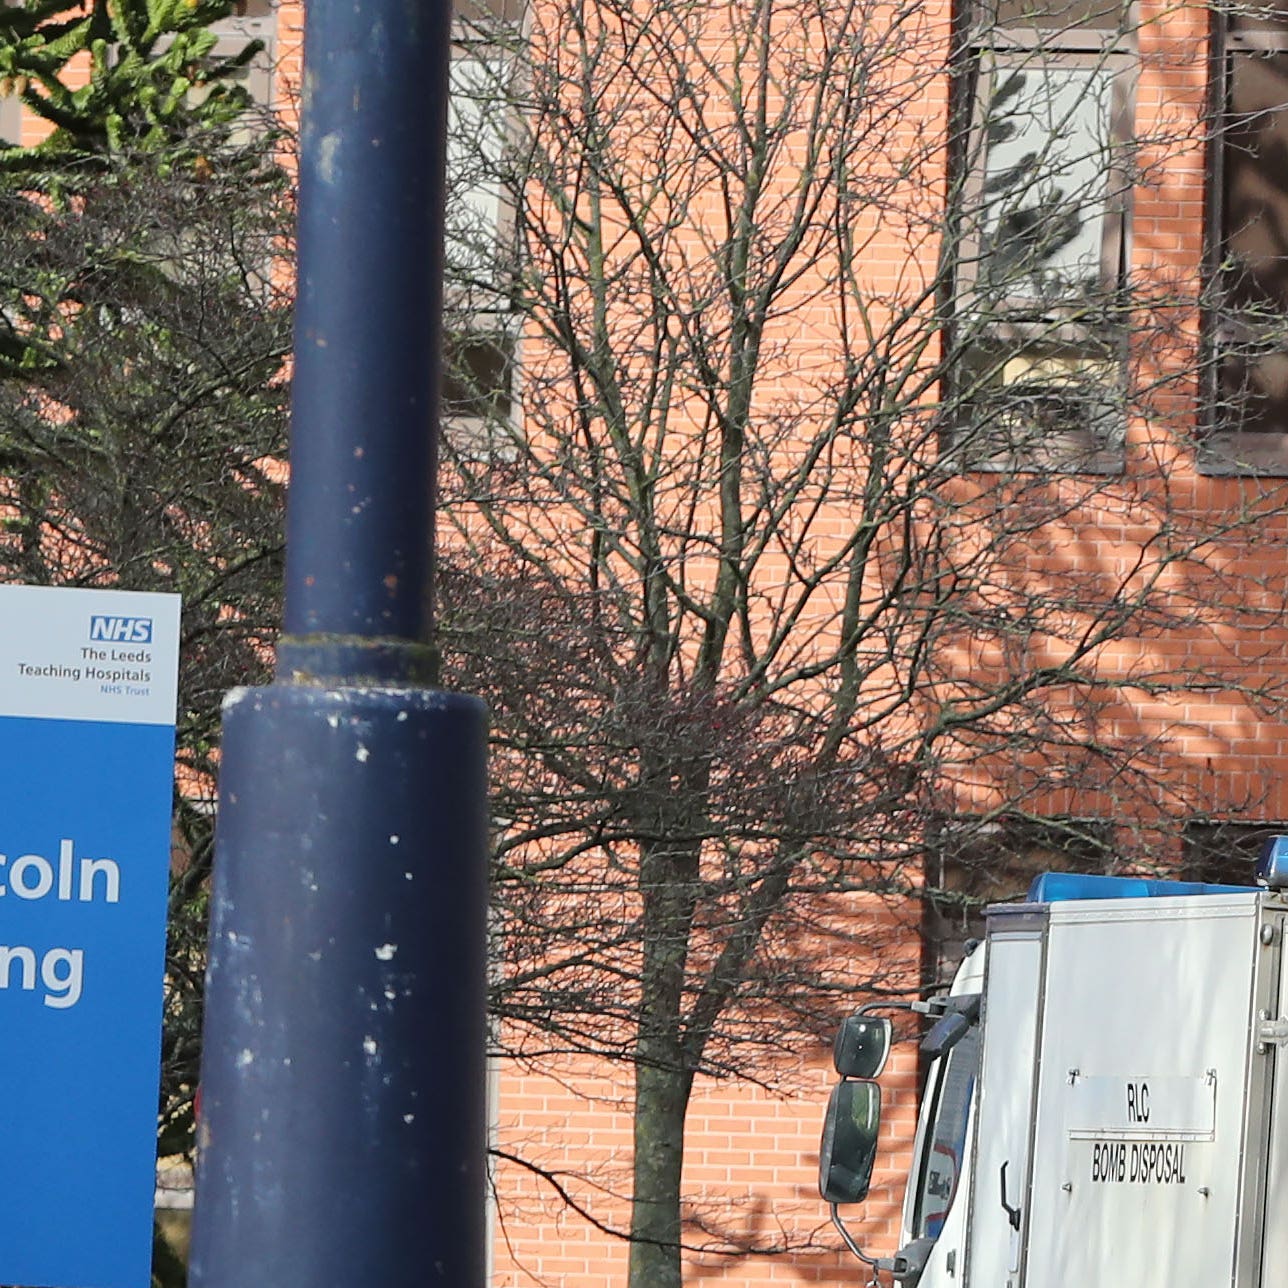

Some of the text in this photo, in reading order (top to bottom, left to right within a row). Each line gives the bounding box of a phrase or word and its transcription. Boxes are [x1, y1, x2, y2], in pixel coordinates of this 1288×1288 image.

[91, 617, 152, 642] NHS
[81, 647, 152, 663] The Leeds
[18, 663, 151, 683] Teaching Hospitals
[100, 685, 150, 696] NHS Trust
[0, 839, 120, 903] oln
[1127, 1083, 1150, 1123] RLC
[1092, 1143, 1186, 1184] BOMB DISPOSAL
